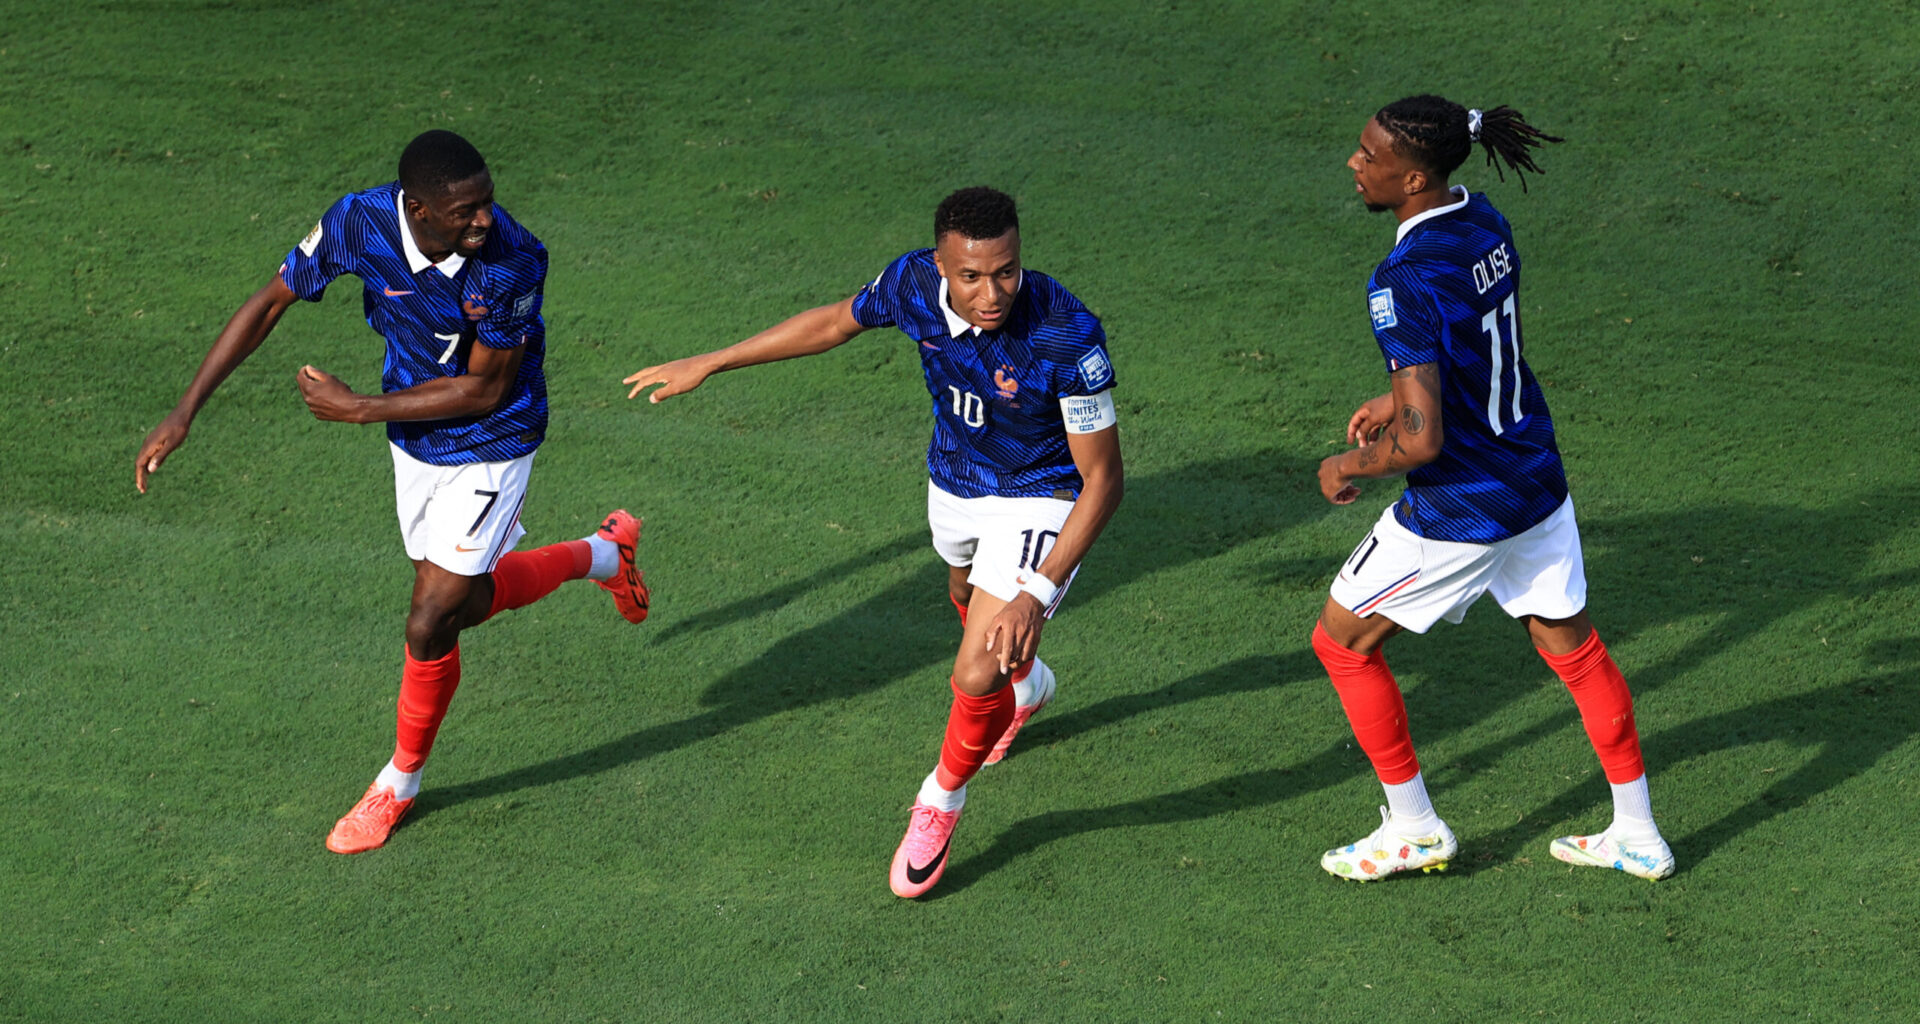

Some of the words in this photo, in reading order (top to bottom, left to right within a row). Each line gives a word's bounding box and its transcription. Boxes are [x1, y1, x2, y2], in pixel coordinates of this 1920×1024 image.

[1472, 242, 1513, 295] OLISE
[434, 333, 460, 364] 7
[1482, 294, 1523, 436] 11
[948, 384, 985, 429] 10
[1068, 405, 1098, 415] UNITES
[1081, 413, 1102, 423] World
[466, 489, 500, 537] 7
